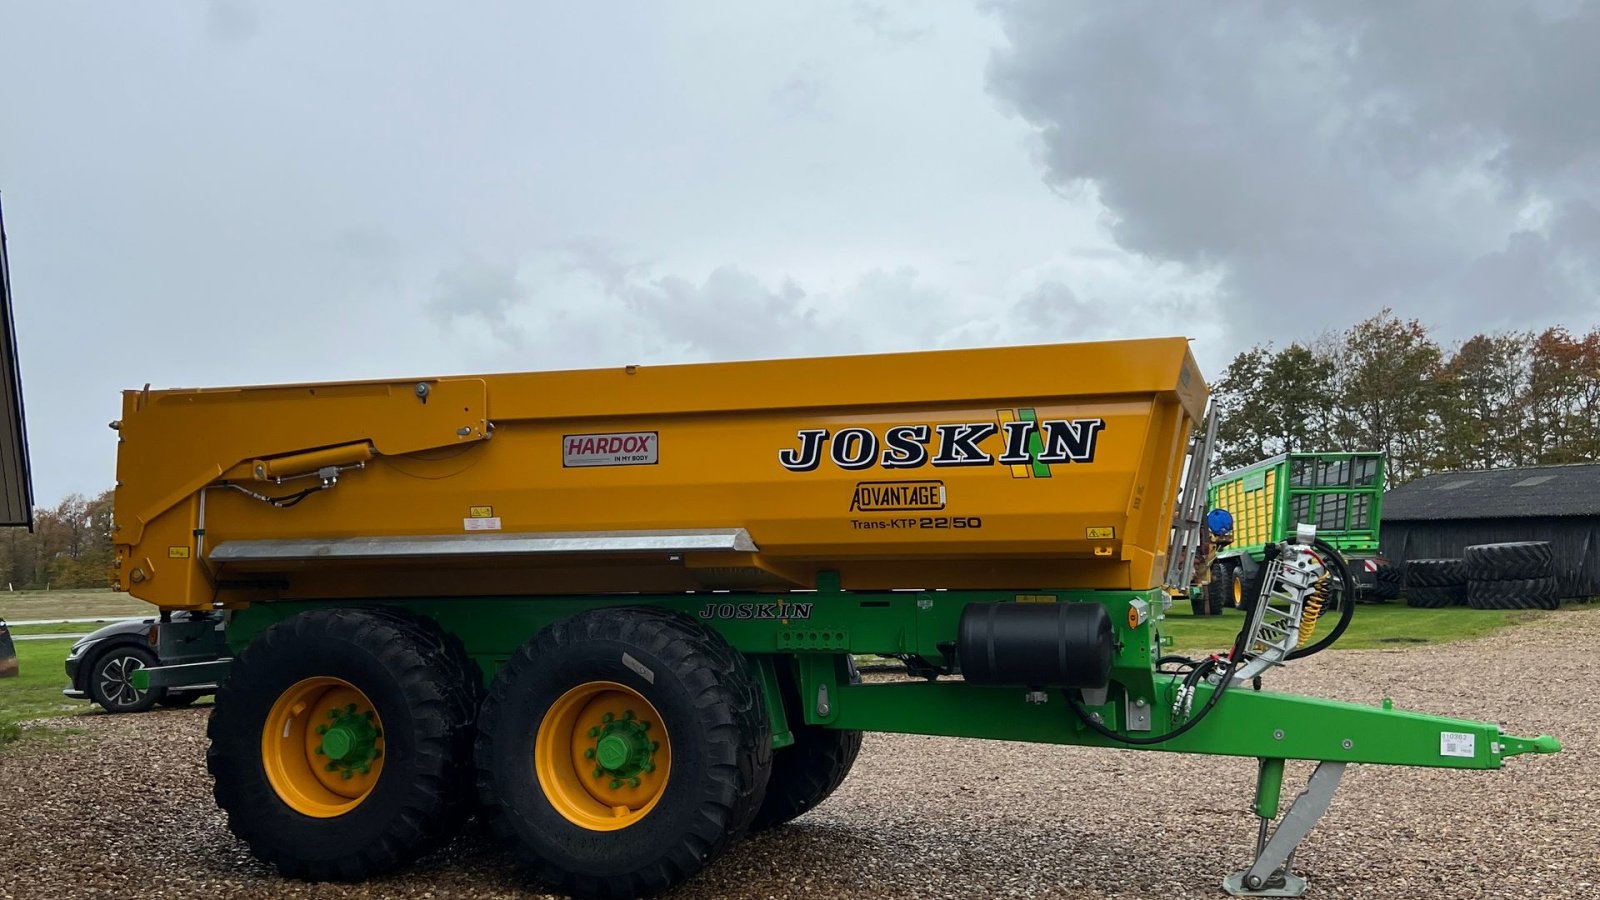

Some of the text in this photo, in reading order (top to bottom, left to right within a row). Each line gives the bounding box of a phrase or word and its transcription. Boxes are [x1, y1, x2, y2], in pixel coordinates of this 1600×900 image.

[778, 418, 1105, 472] JOSKIN
[849, 486, 938, 512] ADVANTAGE
[851, 516, 982, 530] Trans-KTP 22/50
[698, 603, 813, 619] JOSKIN
